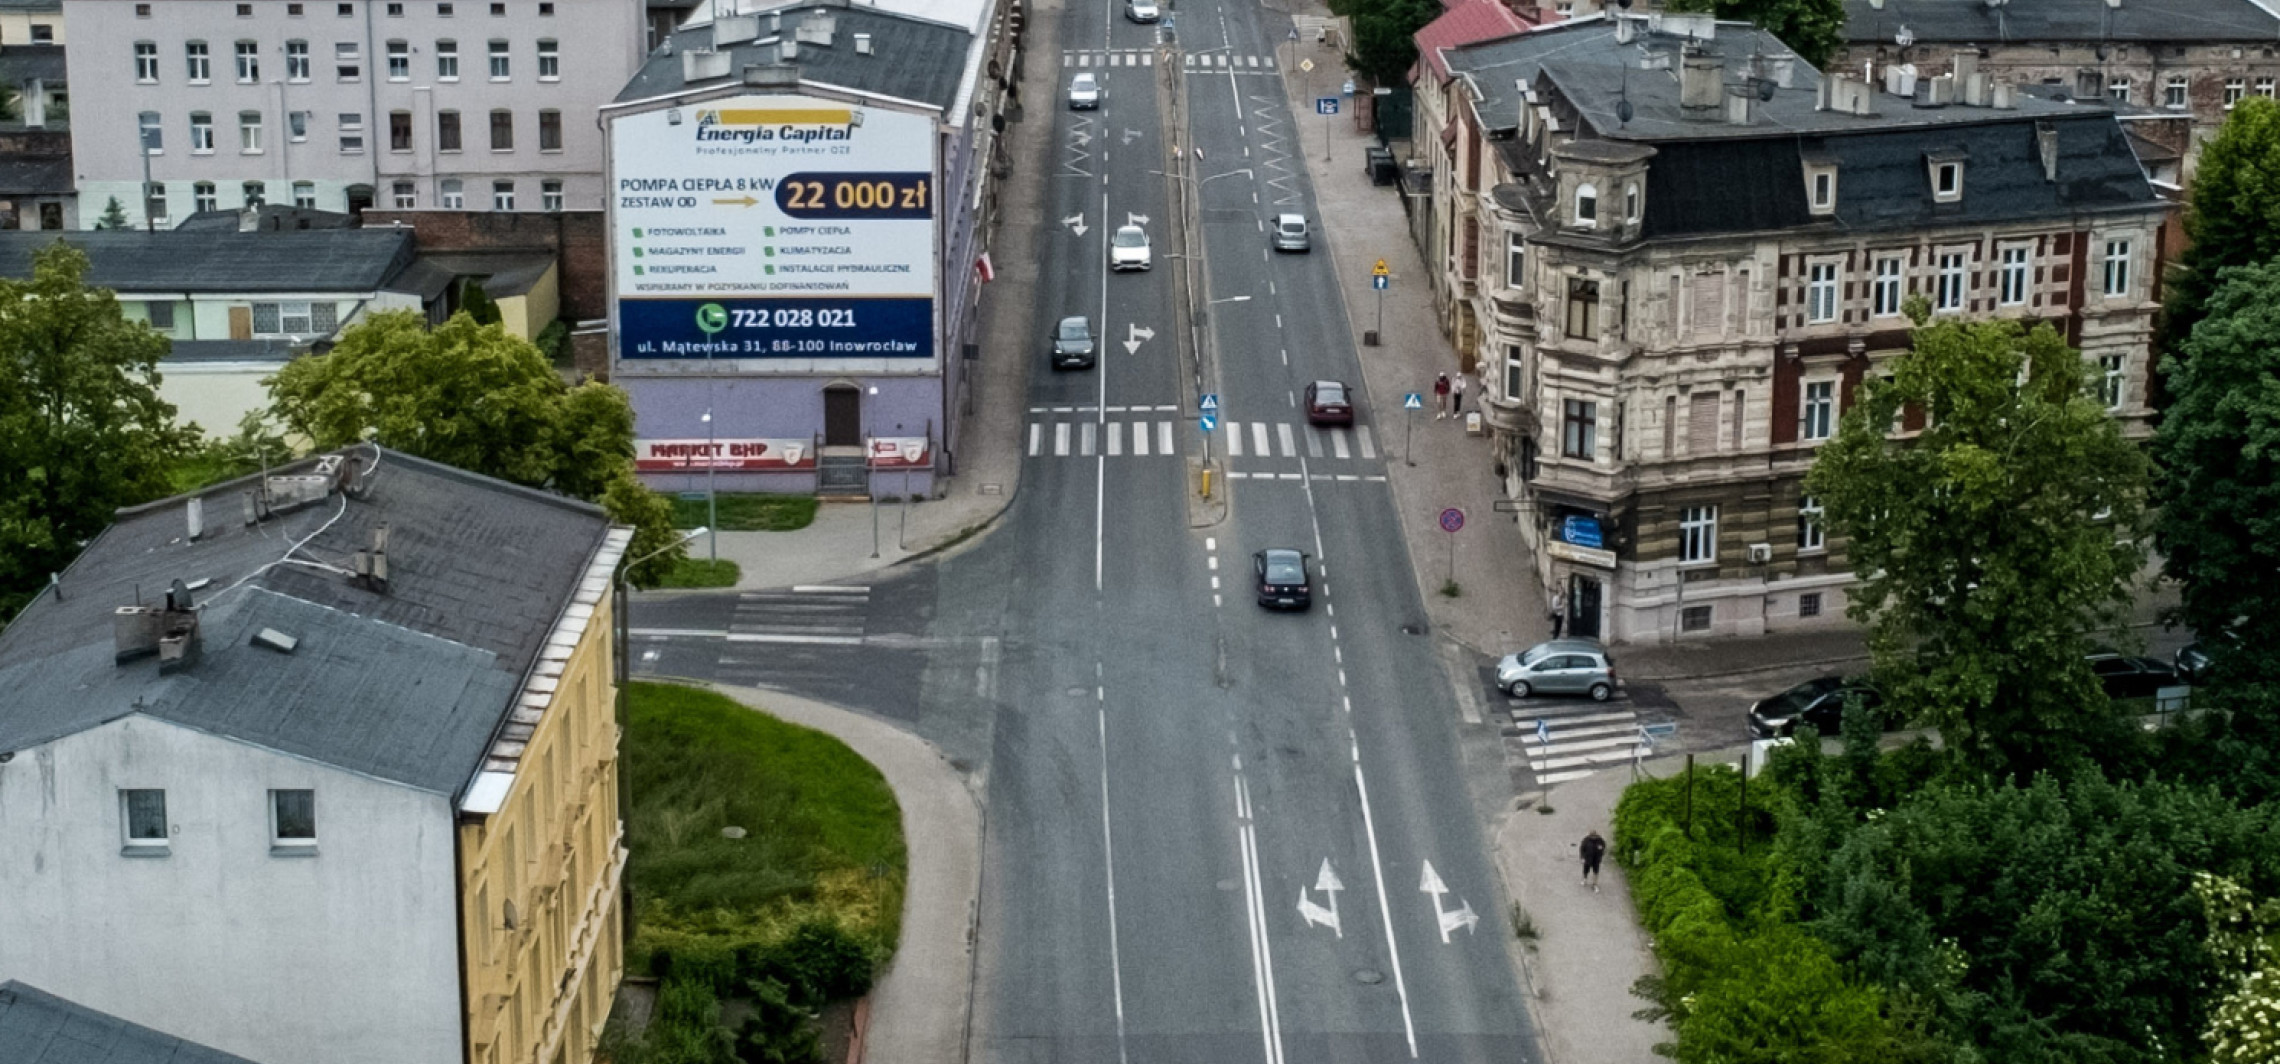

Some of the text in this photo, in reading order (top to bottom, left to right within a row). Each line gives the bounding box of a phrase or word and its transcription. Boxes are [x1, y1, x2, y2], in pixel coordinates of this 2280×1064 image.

[696, 124, 852, 143] Energia Capital
[782, 146, 826, 154] Partner
[620, 178, 775, 191] POMPA CIEPŁA 8 kW
[787, 180, 928, 209] 22 000 zł
[620, 196, 697, 208] ZESTAW OD
[648, 227, 726, 236] FOTOWOLTAIKA
[779, 226, 851, 235] POMPY CIEPŁA
[648, 247, 704, 255] MAGAZYNY
[780, 246, 852, 255] KLIMATYZACJA
[649, 265, 717, 273] REKUPERACJA
[779, 264, 911, 273] INSTALACJE HYDRAULICZNE
[635, 283, 693, 291] WSPIERAMY
[695, 283, 705, 291] W
[707, 283, 767, 291] POZYSKANIU
[731, 309, 856, 328] 722 028 021
[637, 339, 917, 355] ul. Mątewska 31, 88-100 Inowrocław
[651, 443, 768, 457] MARKET BHP
